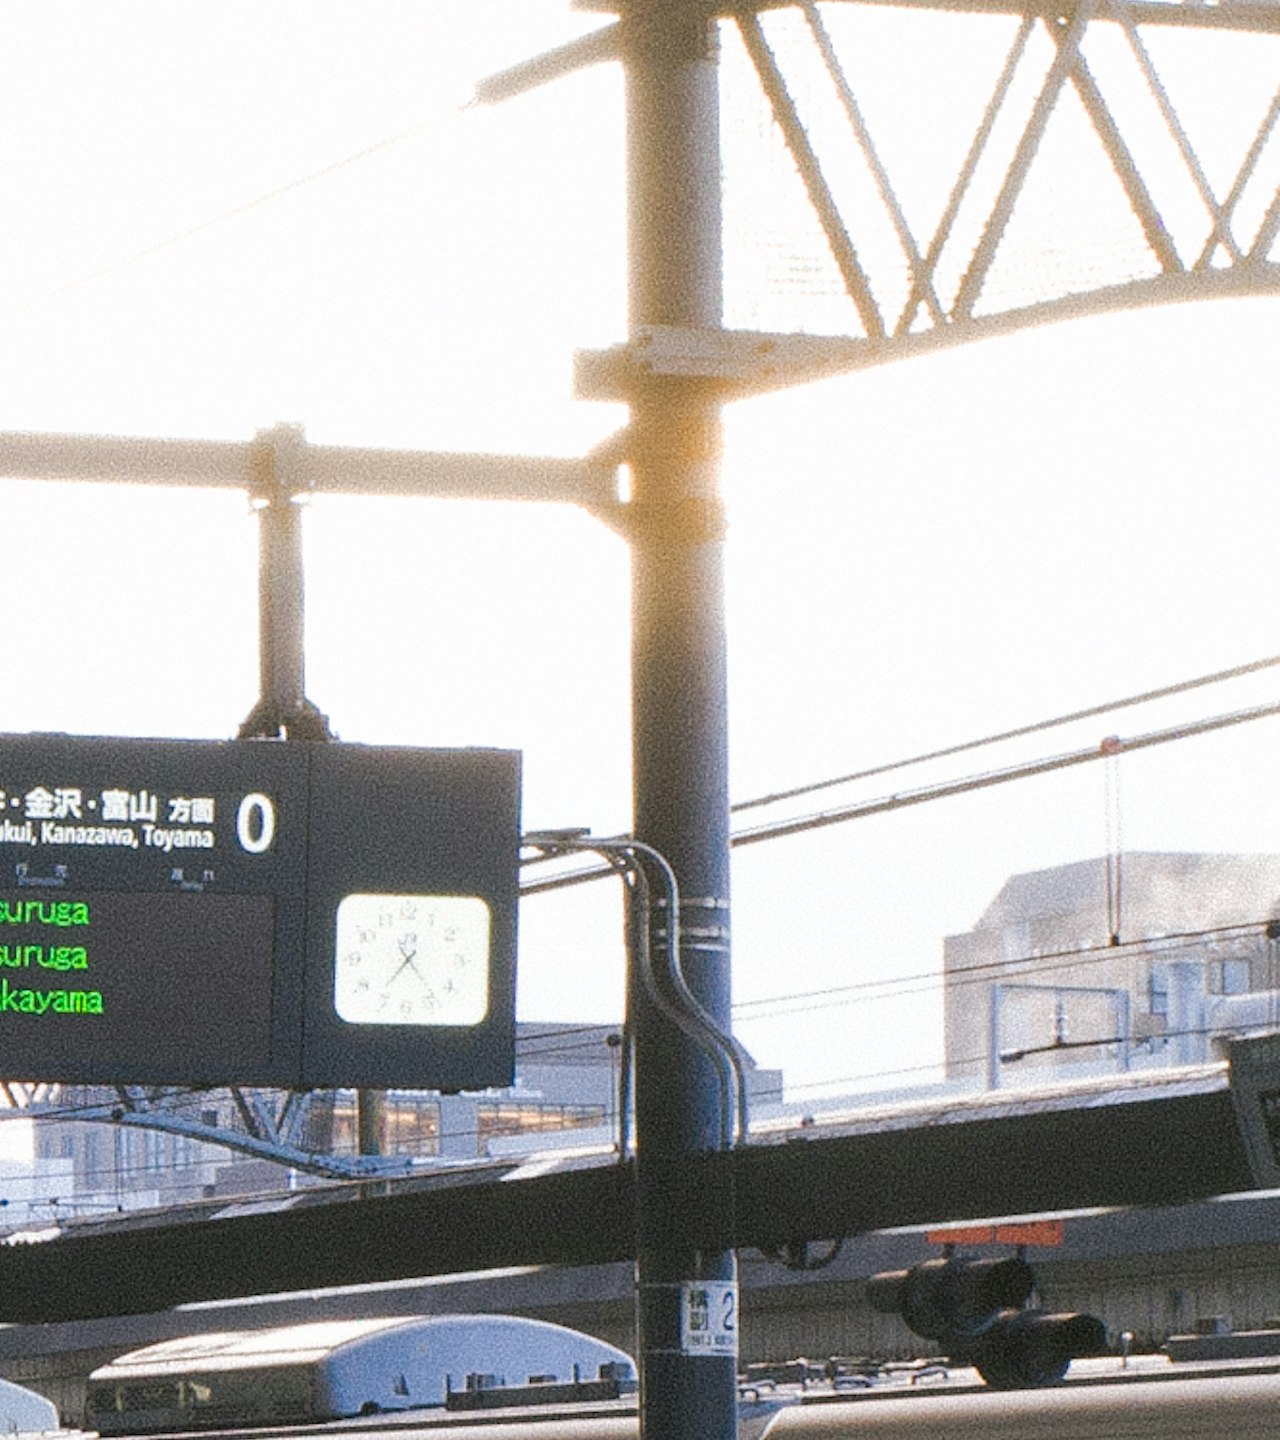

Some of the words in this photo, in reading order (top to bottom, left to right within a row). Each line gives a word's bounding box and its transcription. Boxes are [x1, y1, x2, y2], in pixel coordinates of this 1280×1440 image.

[41, 821, 139, 850] Kanazawa,
[142, 824, 215, 852] Toyama
[237, 792, 276, 853] 0
